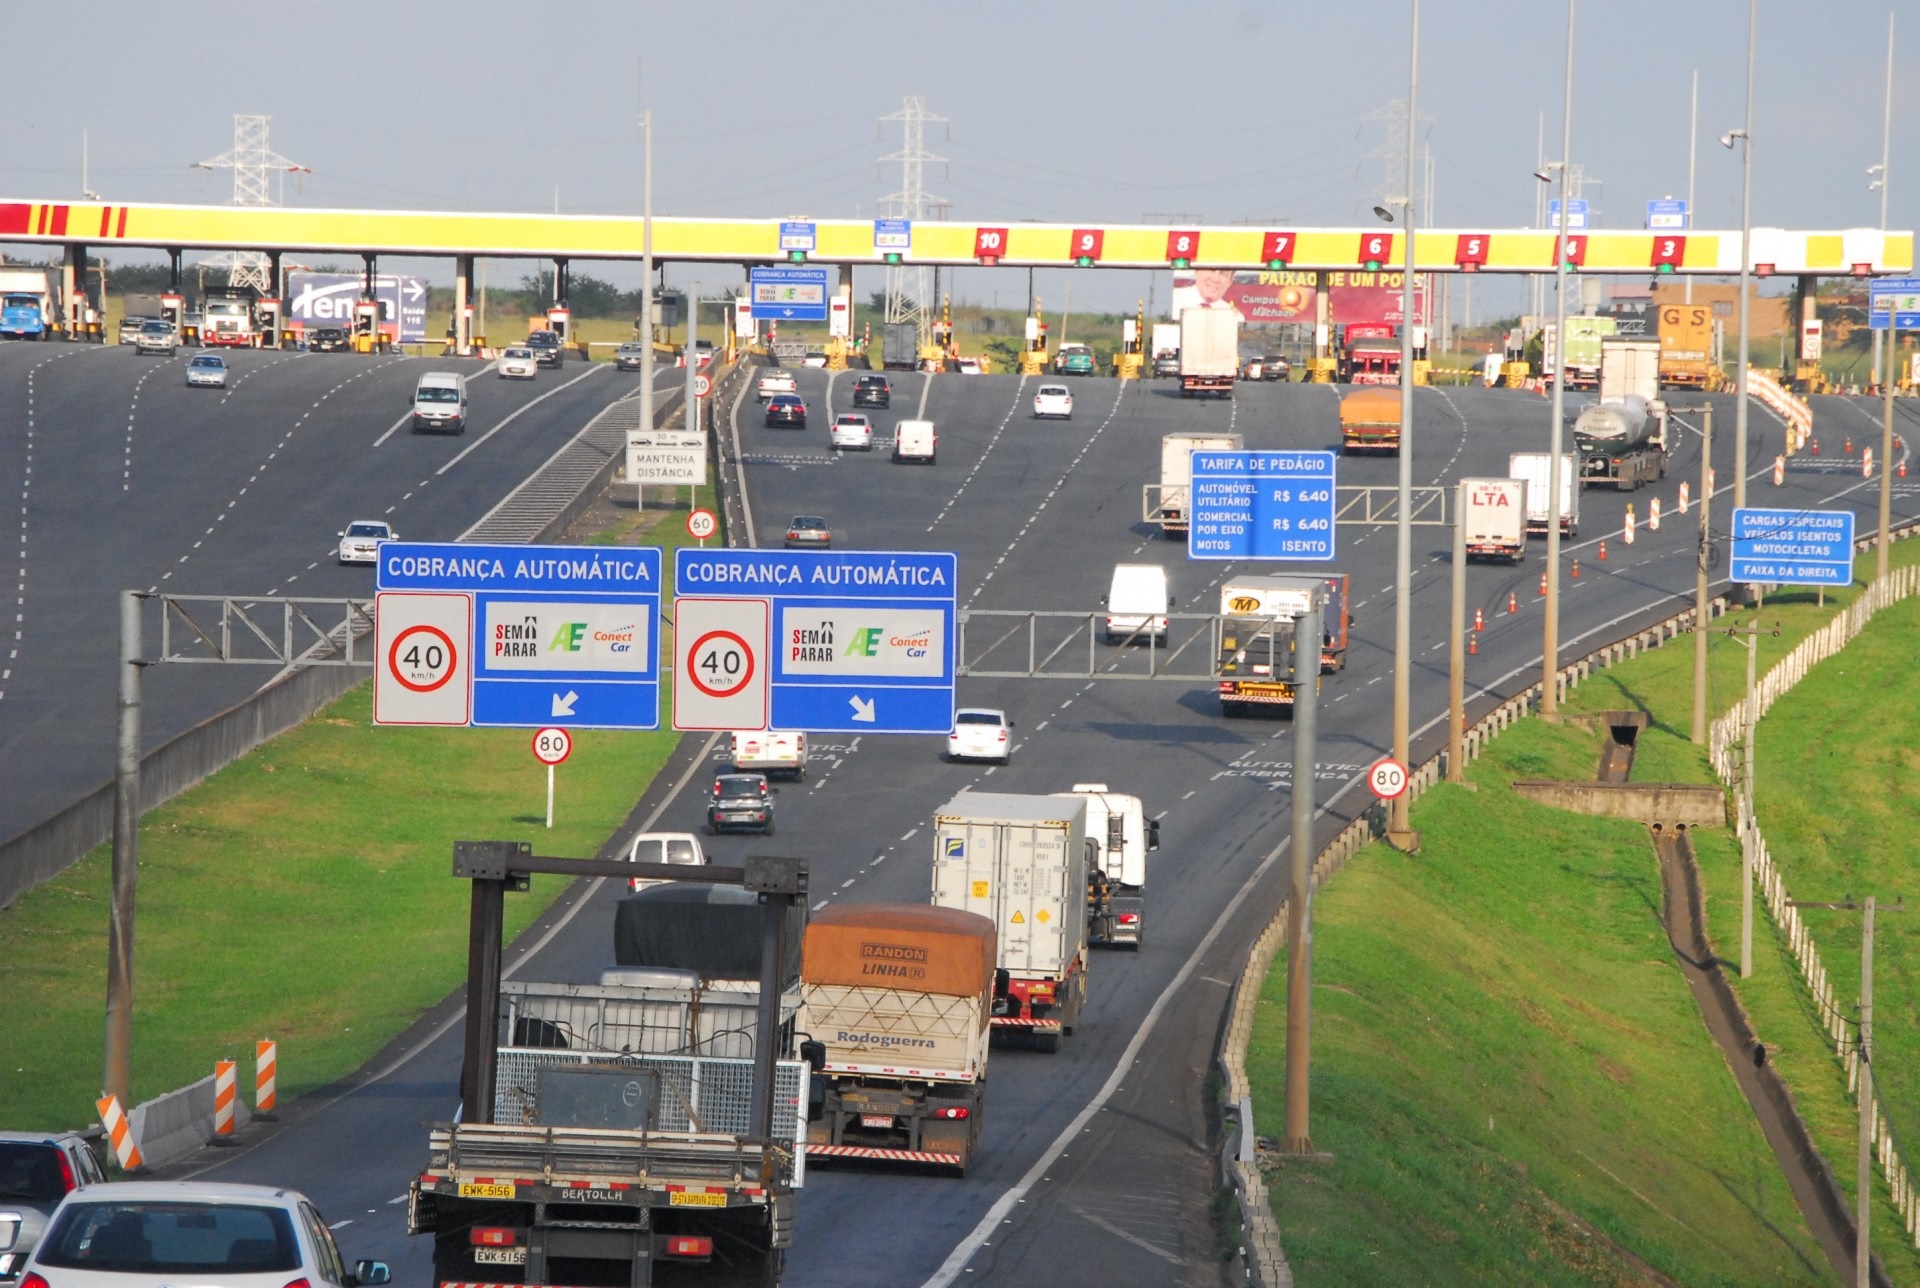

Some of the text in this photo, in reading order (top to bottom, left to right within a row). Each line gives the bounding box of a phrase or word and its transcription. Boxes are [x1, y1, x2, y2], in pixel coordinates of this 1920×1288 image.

[980, 232, 1001, 249] 10
[1081, 234, 1094, 250] 9
[1177, 236, 1190, 252] 8
[1275, 238, 1288, 253] 7
[1369, 239, 1382, 254] 6
[1467, 240, 1480, 255] 5
[1566, 241, 1577, 256] 4
[1661, 241, 1675, 257] 3
[1350, 272, 1376, 287] UM
[1242, 294, 1280, 305] Campos
[1252, 306, 1296, 317] Machado
[1664, 309, 1705, 326] G S
[637, 454, 695, 465] MANTENHA
[1201, 456, 1325, 470] TARIFA DE PEDÁGIO
[638, 466, 694, 477] DISTÂNCIA
[1198, 481, 1258, 494] AUTOMÓVEL
[1198, 495, 1251, 507] UTILITÁRIO
[1273, 490, 1290, 503] R$
[1473, 493, 1509, 507] LTA
[693, 518, 710, 529] 60
[1197, 512, 1253, 522] COMERCIAL
[1742, 515, 1844, 528] CARGAS ESPECIAIS
[1197, 525, 1244, 535] POR EIXO
[1273, 518, 1290, 531] R$
[1744, 527, 1841, 542] VEÍCULOS ISENTOS
[1197, 540, 1326, 551] MOTOS ISENTO
[1753, 544, 1830, 555] MOTOCICLETAS
[388, 554, 650, 581] COBRANÇA AUTOMÁTICA
[686, 560, 946, 586] COBRANÇA AUTOMÁTICA
[1744, 565, 1837, 578] FAIXA DA DIREITA
[1234, 597, 1252, 611] TM
[496, 624, 523, 639] SEM
[549, 622, 588, 652] AE
[594, 630, 633, 642] Conect
[792, 629, 819, 644] SEM
[610, 642, 631, 653] Car
[844, 627, 884, 657] AE
[890, 636, 928, 647] Conect
[496, 642, 537, 657] PARAR
[792, 647, 833, 662] PARAR
[906, 647, 926, 658] Car
[403, 645, 443, 669] 40
[701, 650, 741, 674] 40
[411, 671, 435, 680] km/h
[709, 676, 733, 685] km/h
[540, 736, 564, 751] 80
[1376, 770, 1401, 786] 80
[862, 946, 925, 961] RANDON
[862, 963, 907, 977] LINHA
[837, 1030, 935, 1048] Rodoguerra
[858, 1103, 898, 1112] RANDON
[463, 1185, 510, 1196] EWK-5156
